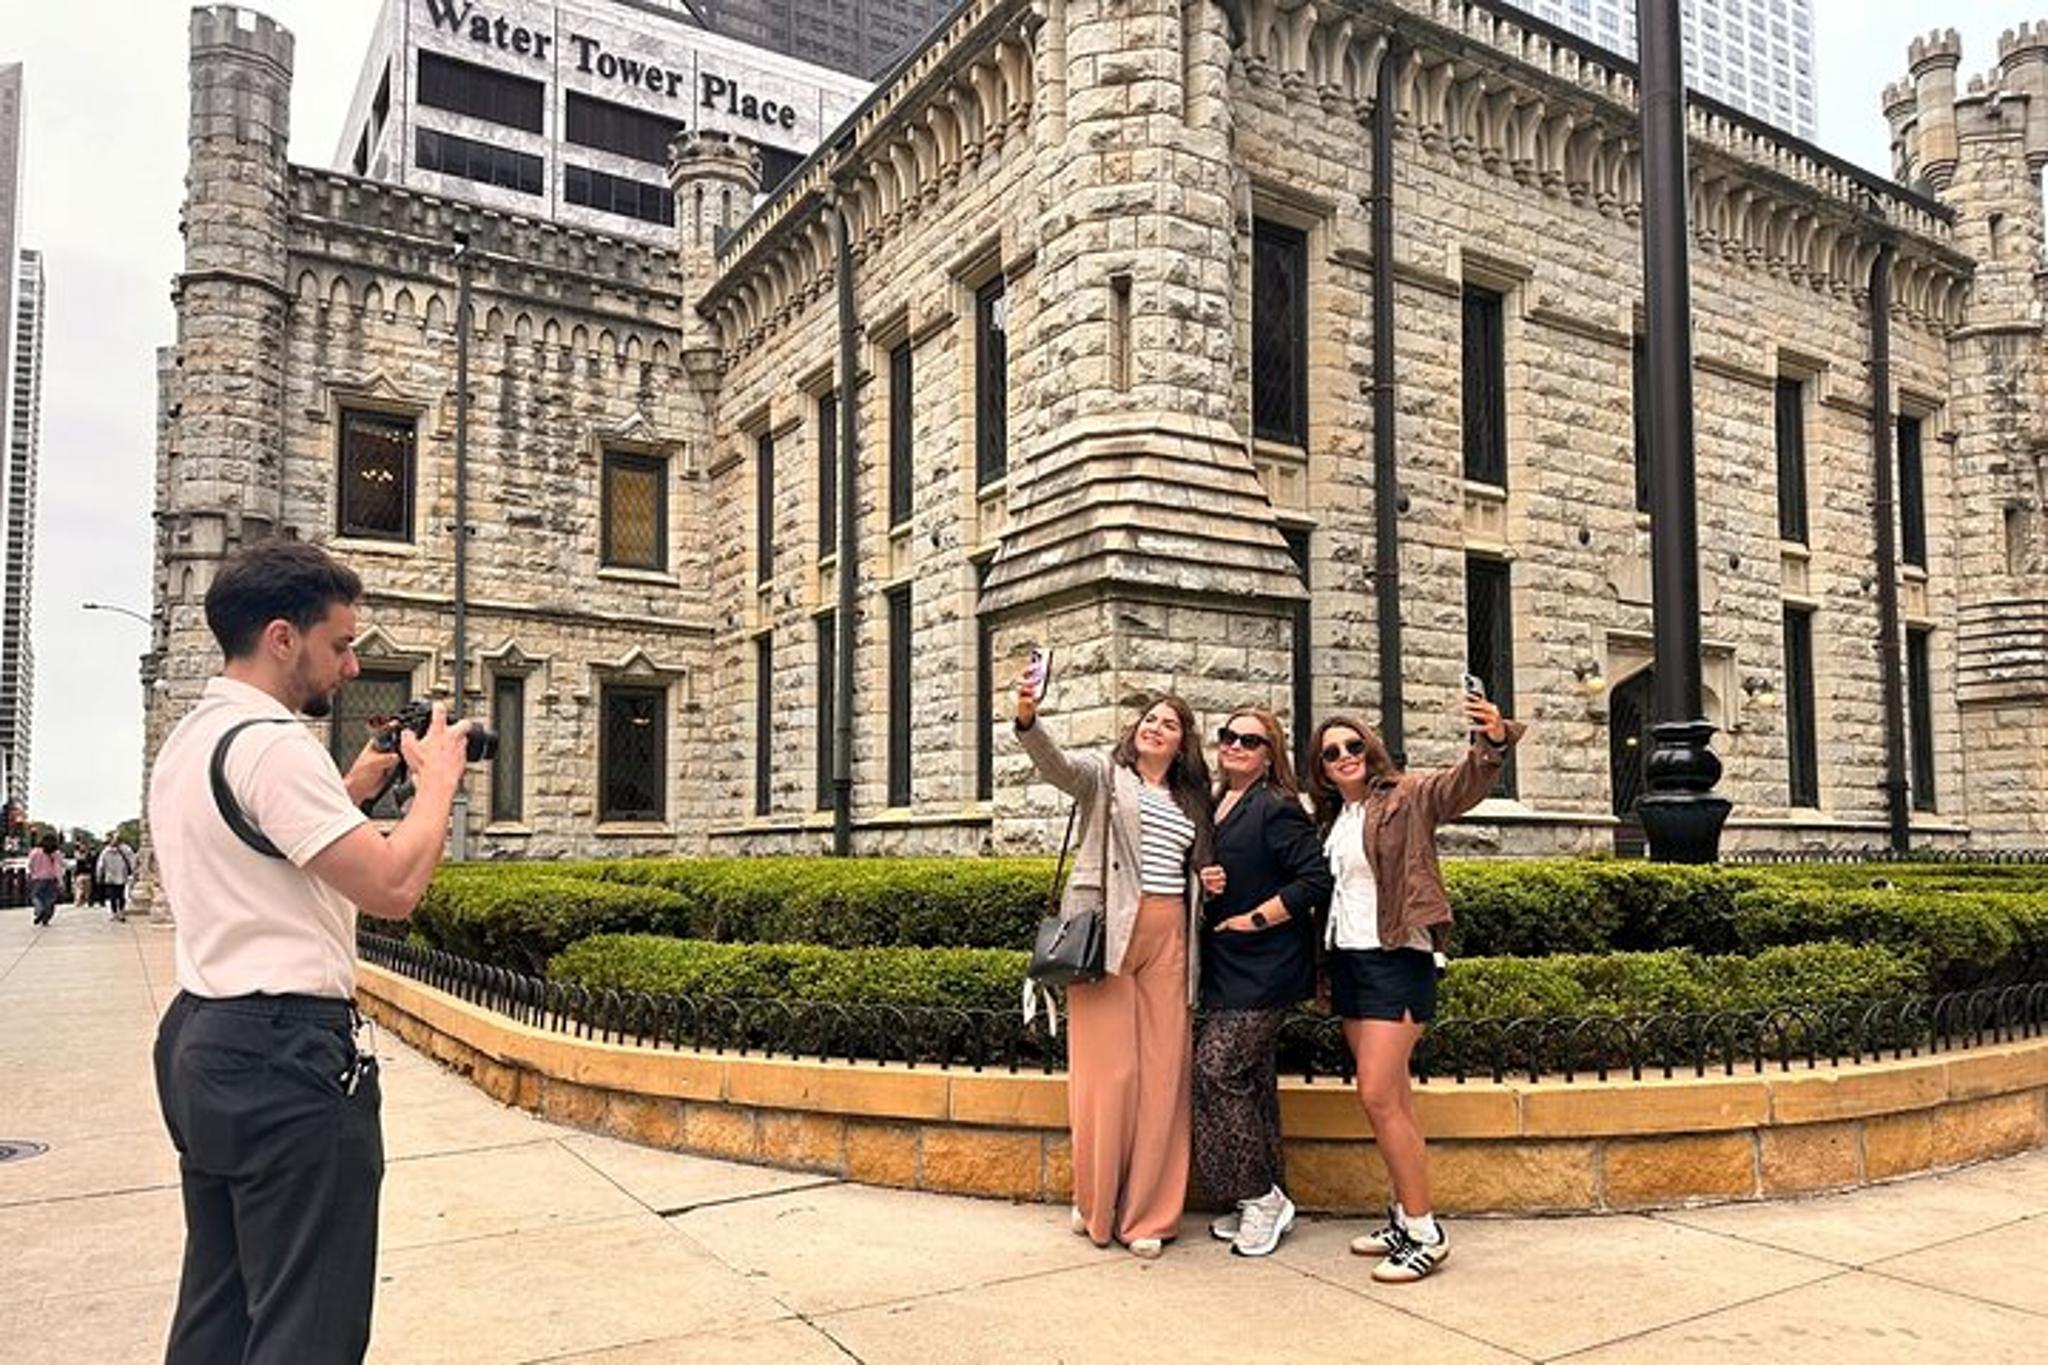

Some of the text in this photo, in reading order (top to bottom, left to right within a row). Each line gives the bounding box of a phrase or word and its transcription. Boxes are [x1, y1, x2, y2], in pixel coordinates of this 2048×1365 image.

[426, 0, 796, 130] Water Tower Place
